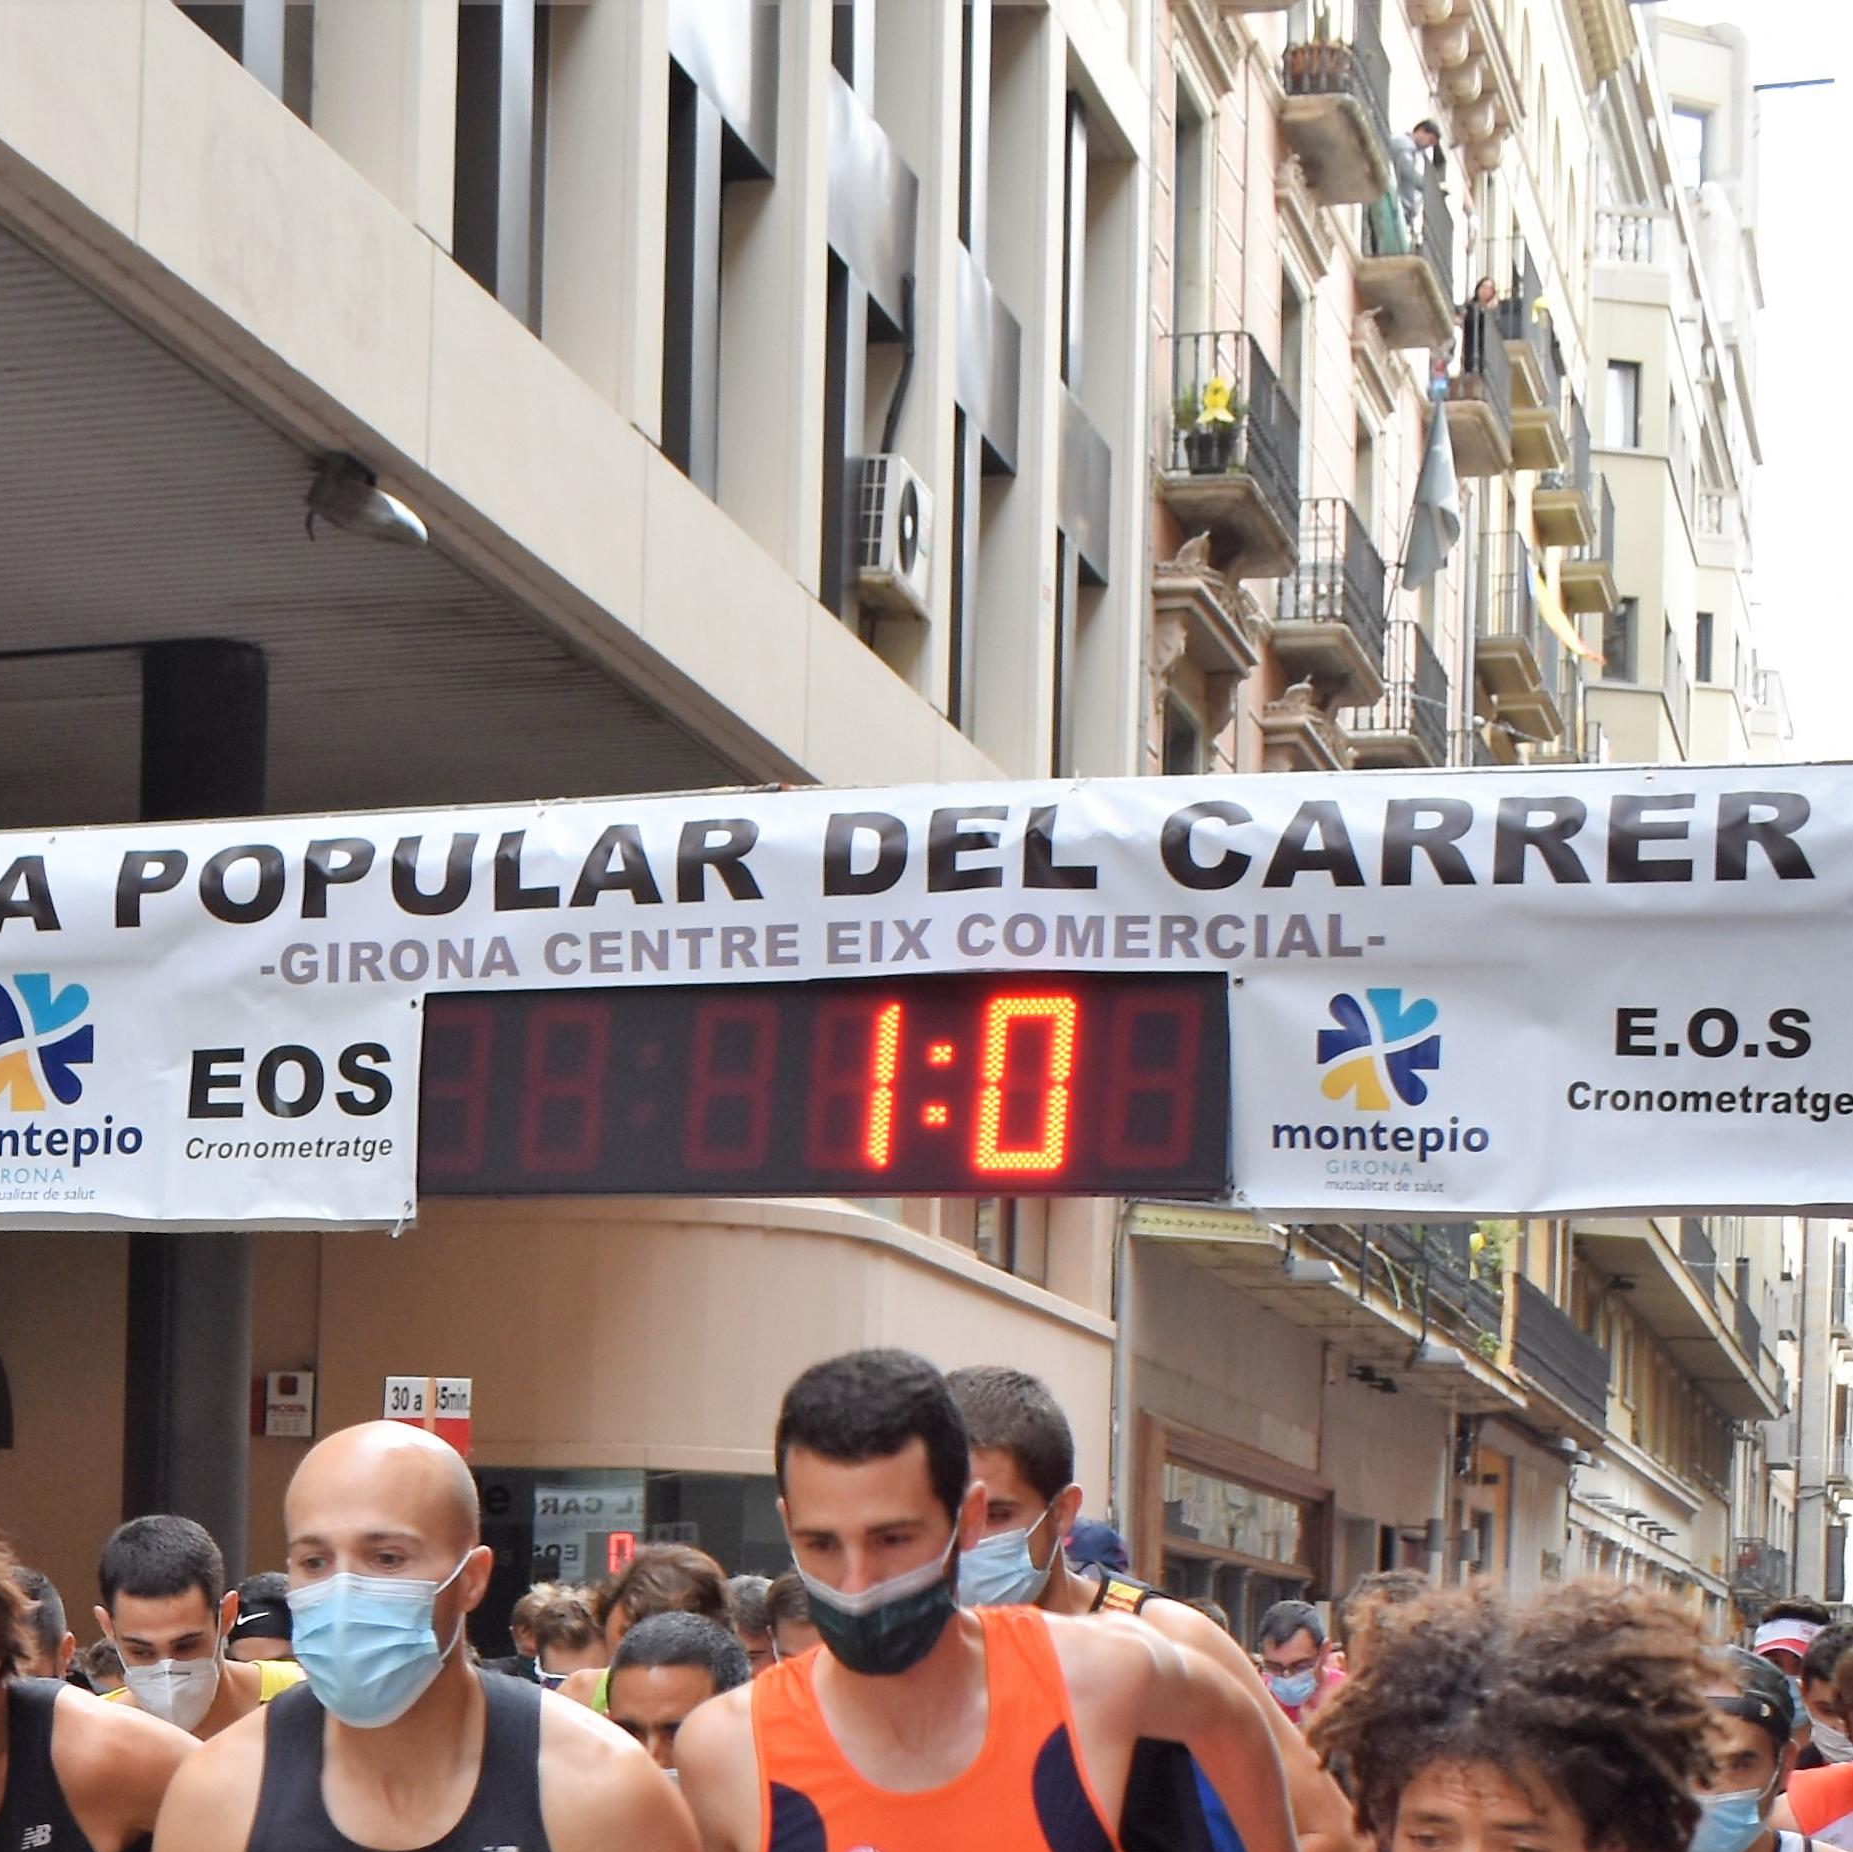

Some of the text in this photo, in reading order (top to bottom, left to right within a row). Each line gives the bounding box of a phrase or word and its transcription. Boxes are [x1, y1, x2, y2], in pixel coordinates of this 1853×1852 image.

[113, 818, 765, 929] POPULAR
[822, 804, 1098, 897] DEL
[1159, 791, 1817, 891] CARRER
[260, 912, 1386, 986] -GIRONA CENTRE EIX COMERCIAL-
[1615, 1007, 1812, 1059] E.O.S
[187, 1042, 393, 1119] EOS
[866, 995, 1078, 1171] 1:0
[1567, 1080, 1853, 1123] Cronometratge
[185, 1134, 393, 1162] Cronometratge
[1272, 1115, 1490, 1163] montepio
[1324, 1179, 1445, 1193] mutualitat de salut
[1325, 1159, 1413, 1175] GIRONA
[42, 1187, 59, 1201] de
[63, 1187, 97, 1201] salut
[391, 1386, 409, 1411] 30
[414, 1394, 423, 1412] a
